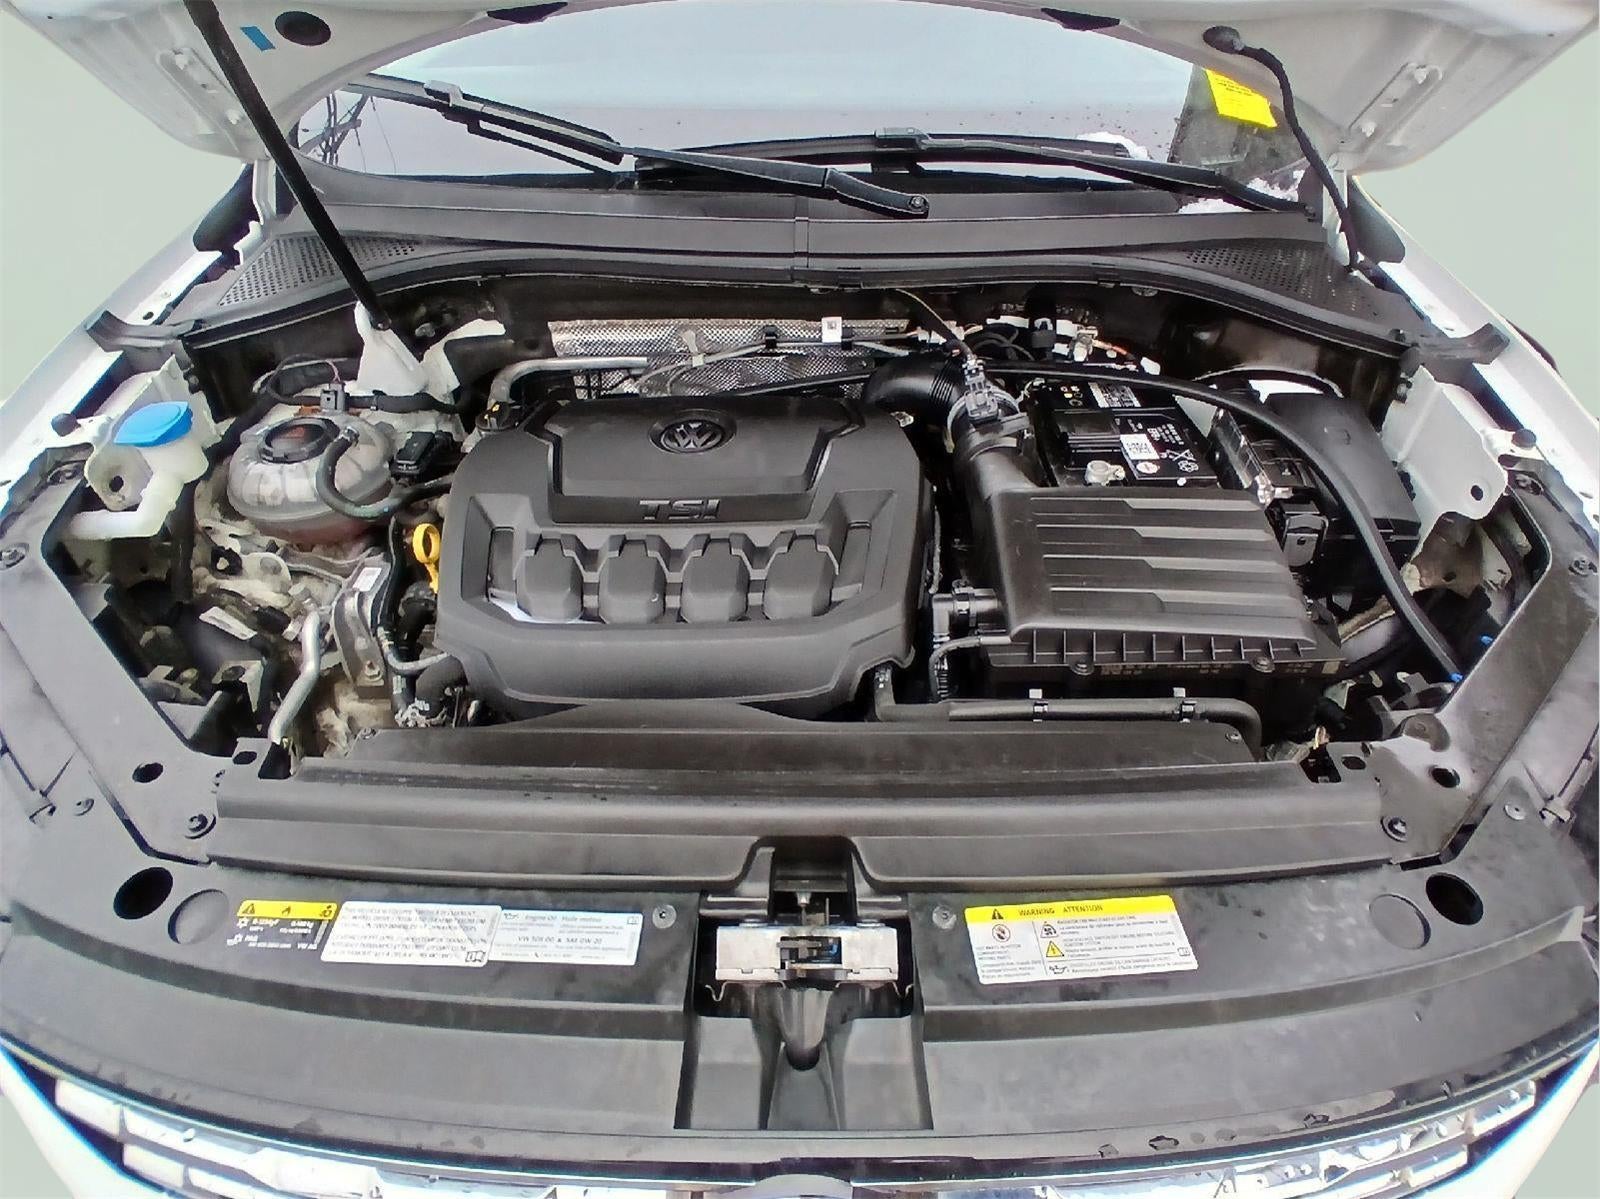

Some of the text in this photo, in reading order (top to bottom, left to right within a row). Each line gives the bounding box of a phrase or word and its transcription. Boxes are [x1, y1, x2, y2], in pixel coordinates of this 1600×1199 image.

[639, 499, 720, 520] TSI
[1019, 905, 1103, 916] WARNING ATTENTION
